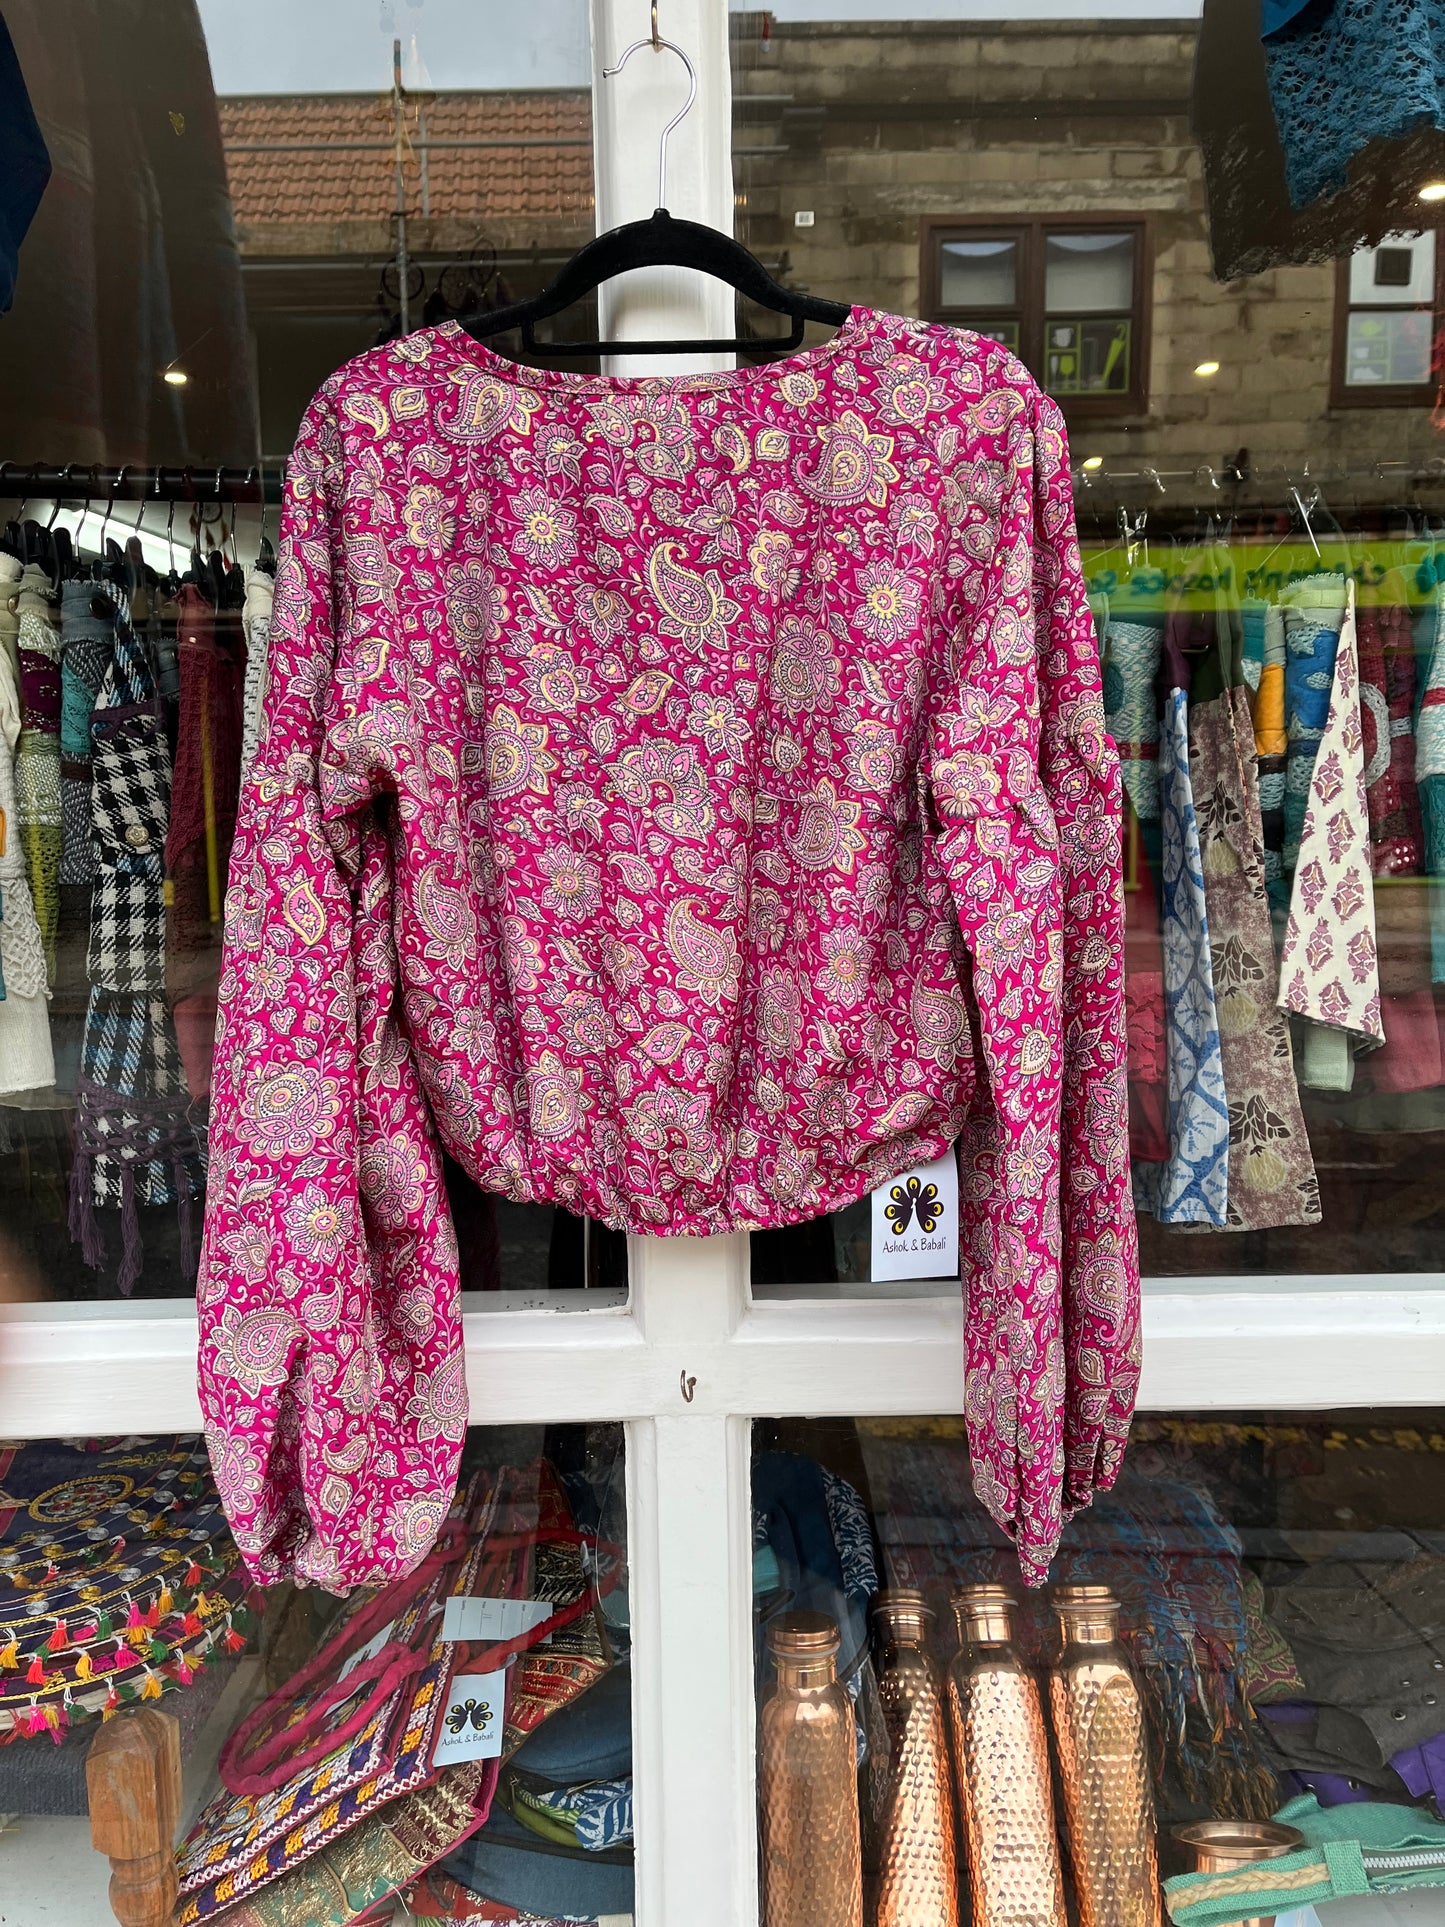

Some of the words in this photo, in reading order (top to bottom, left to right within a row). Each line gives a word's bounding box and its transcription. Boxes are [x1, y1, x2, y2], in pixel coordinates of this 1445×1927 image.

[883, 1240, 909, 1253] Ashok
[910, 1239, 919, 1251] &
[920, 1237, 946, 1251] Babali
[464, 1734, 471, 1743] &
